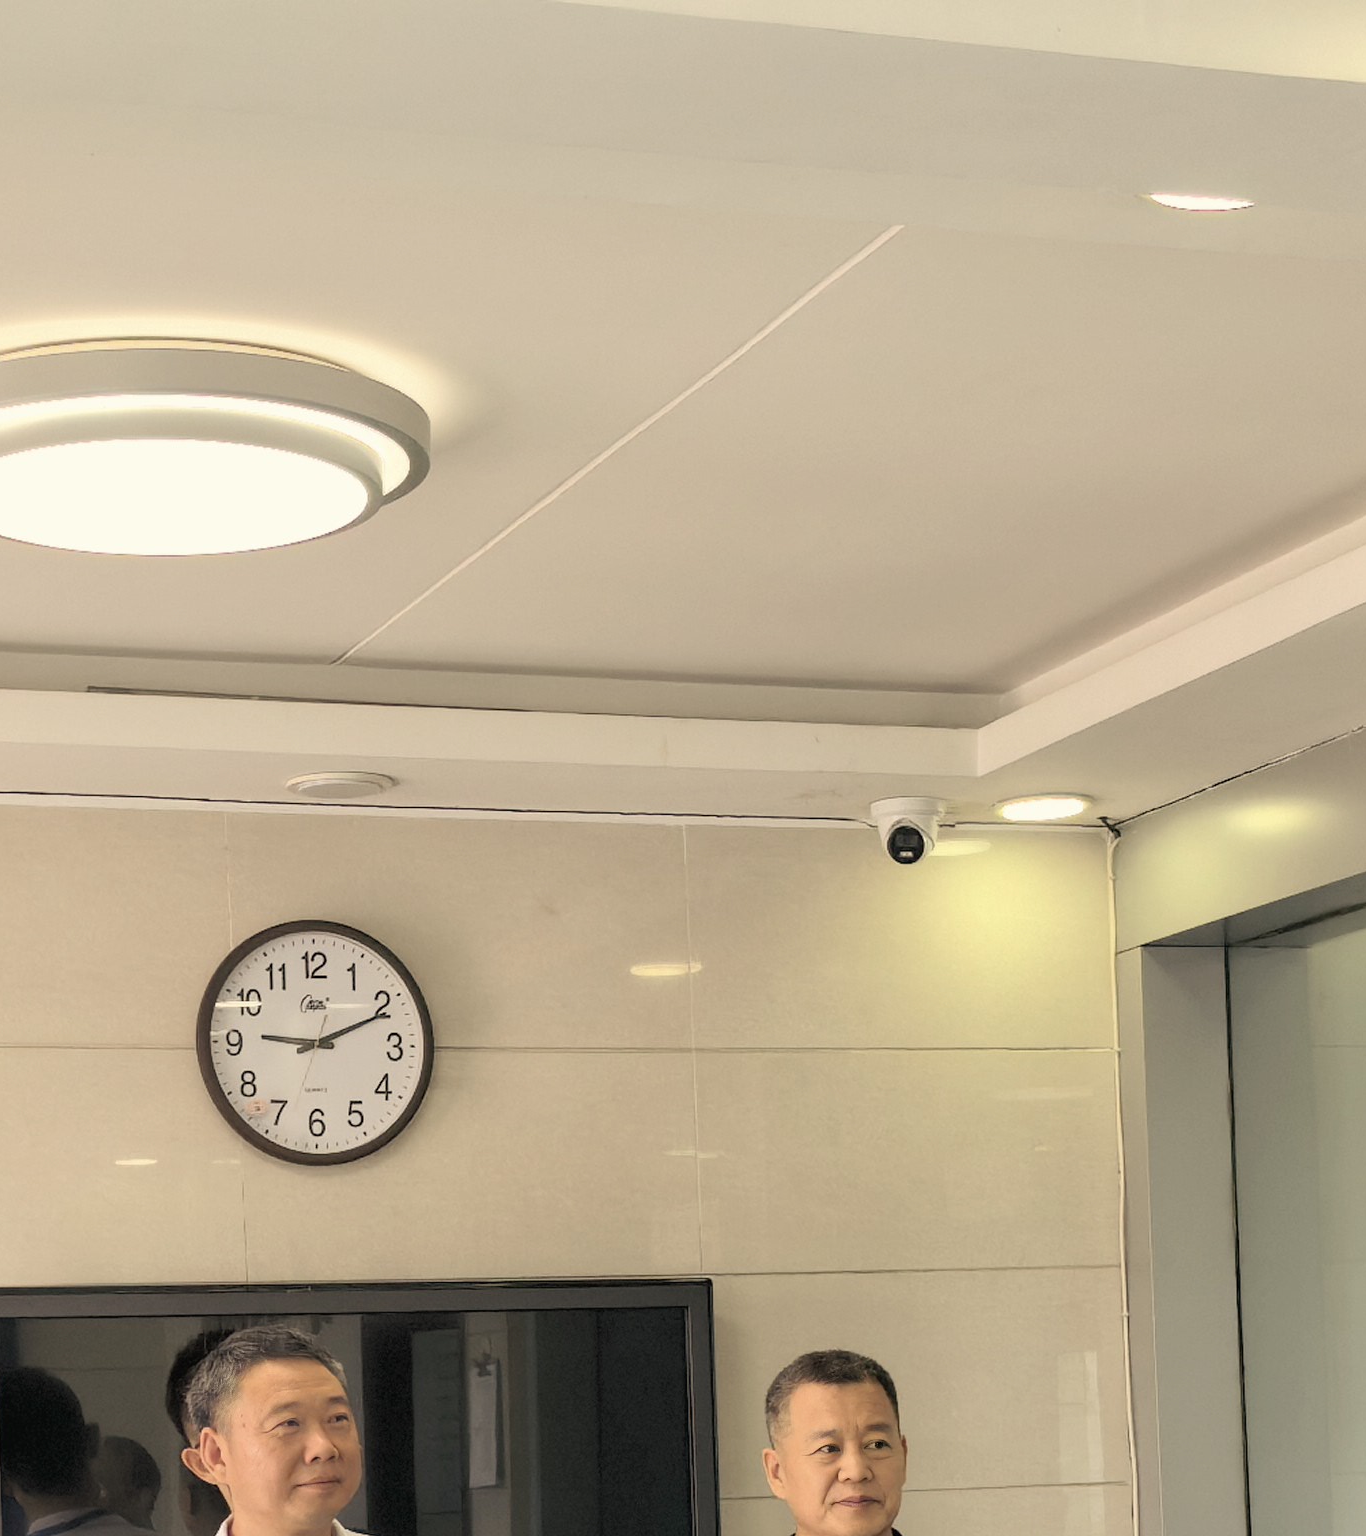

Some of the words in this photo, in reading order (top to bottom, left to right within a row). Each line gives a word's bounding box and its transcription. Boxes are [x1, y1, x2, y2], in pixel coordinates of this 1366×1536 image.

[265, 962, 286, 990] 11
[300, 951, 328, 979] 12
[346, 962, 356, 991] 1
[236, 988, 262, 1016] 10
[373, 990, 391, 1018] 2
[226, 1029, 243, 1056] 9
[386, 1032, 403, 1061] 3
[240, 1070, 257, 1097] 8
[374, 1073, 392, 1101] 4
[270, 1099, 288, 1126] 7
[308, 1108, 326, 1137] 6
[347, 1100, 364, 1128] 5
